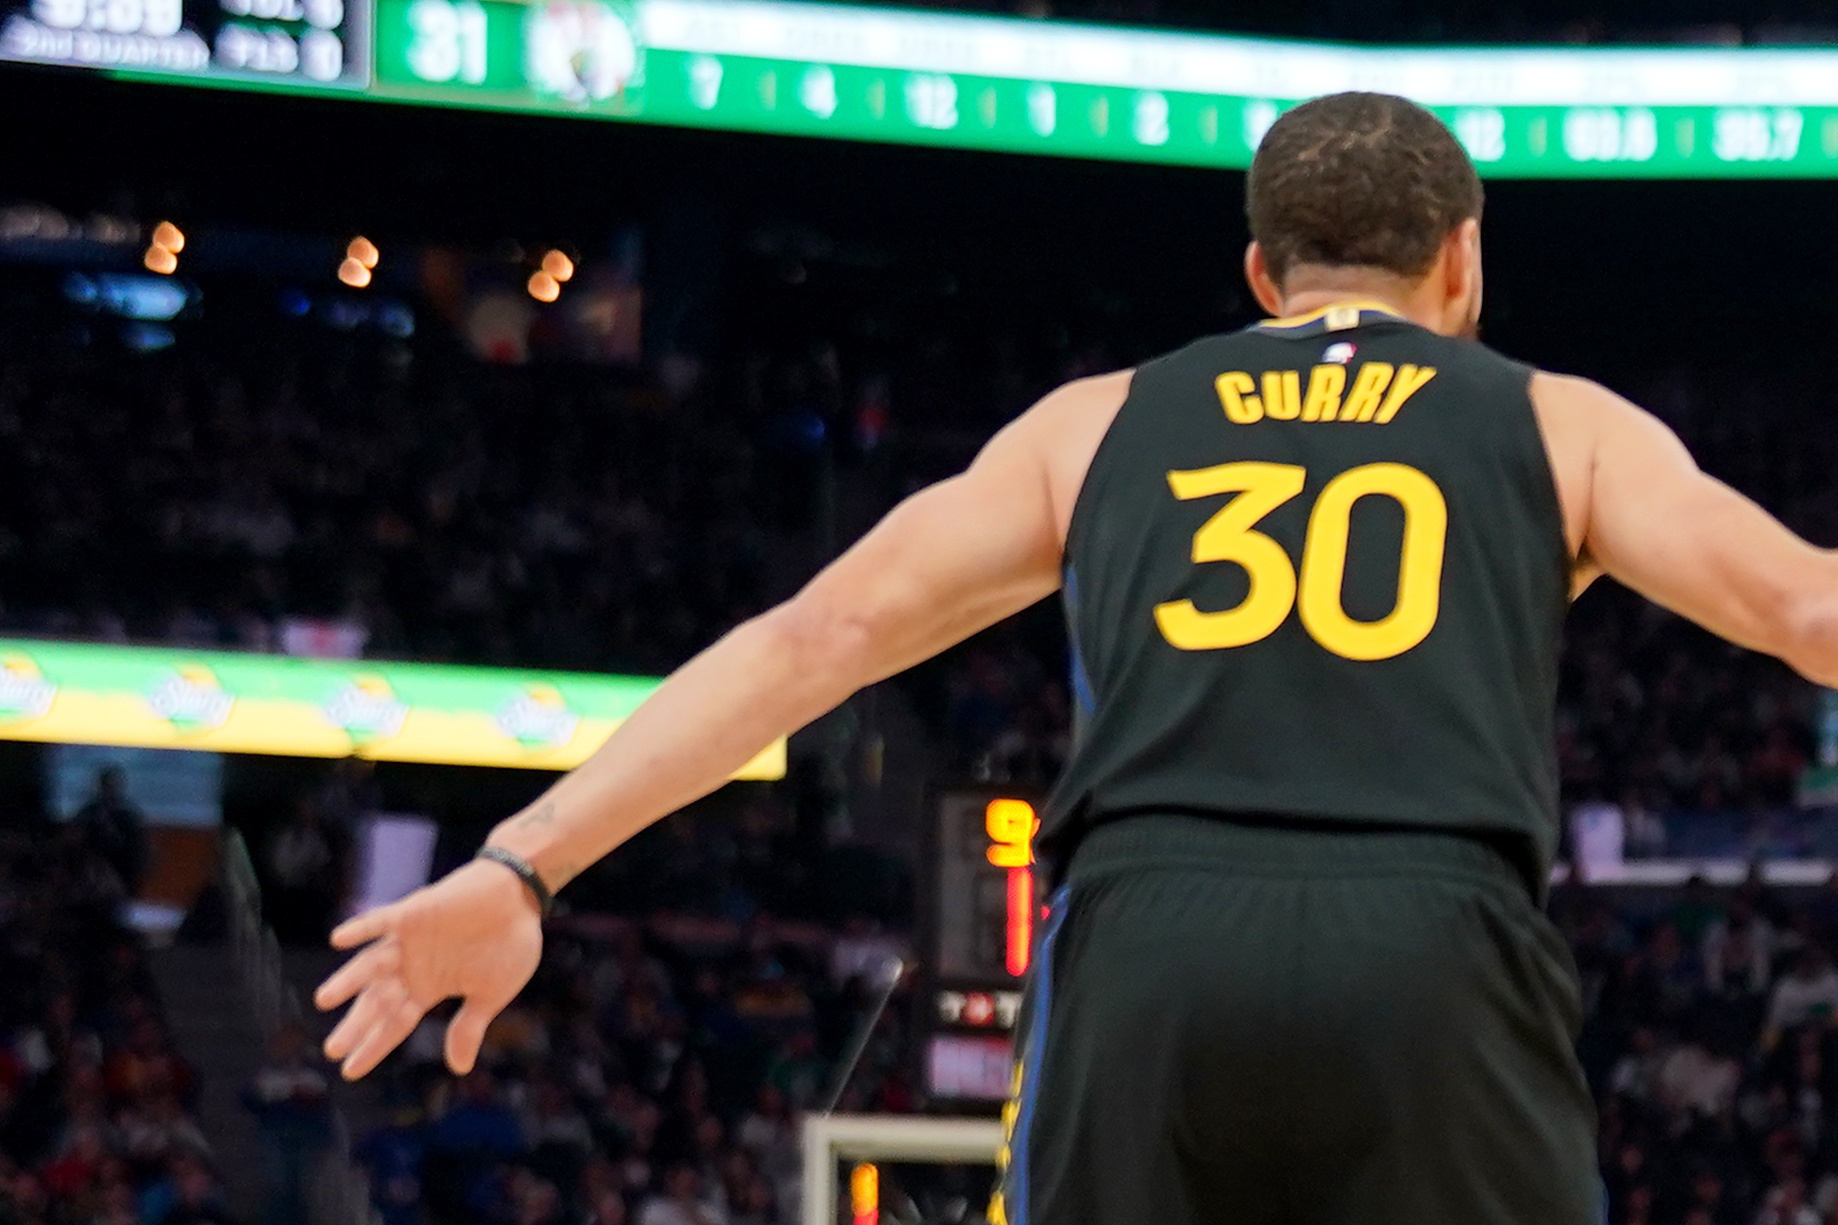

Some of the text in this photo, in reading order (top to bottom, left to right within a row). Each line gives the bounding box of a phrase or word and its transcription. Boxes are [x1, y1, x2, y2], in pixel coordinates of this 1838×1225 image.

[408, 2, 487, 84] 31
[1214, 360, 1438, 425] CURRY
[1153, 461, 1448, 661] 30
